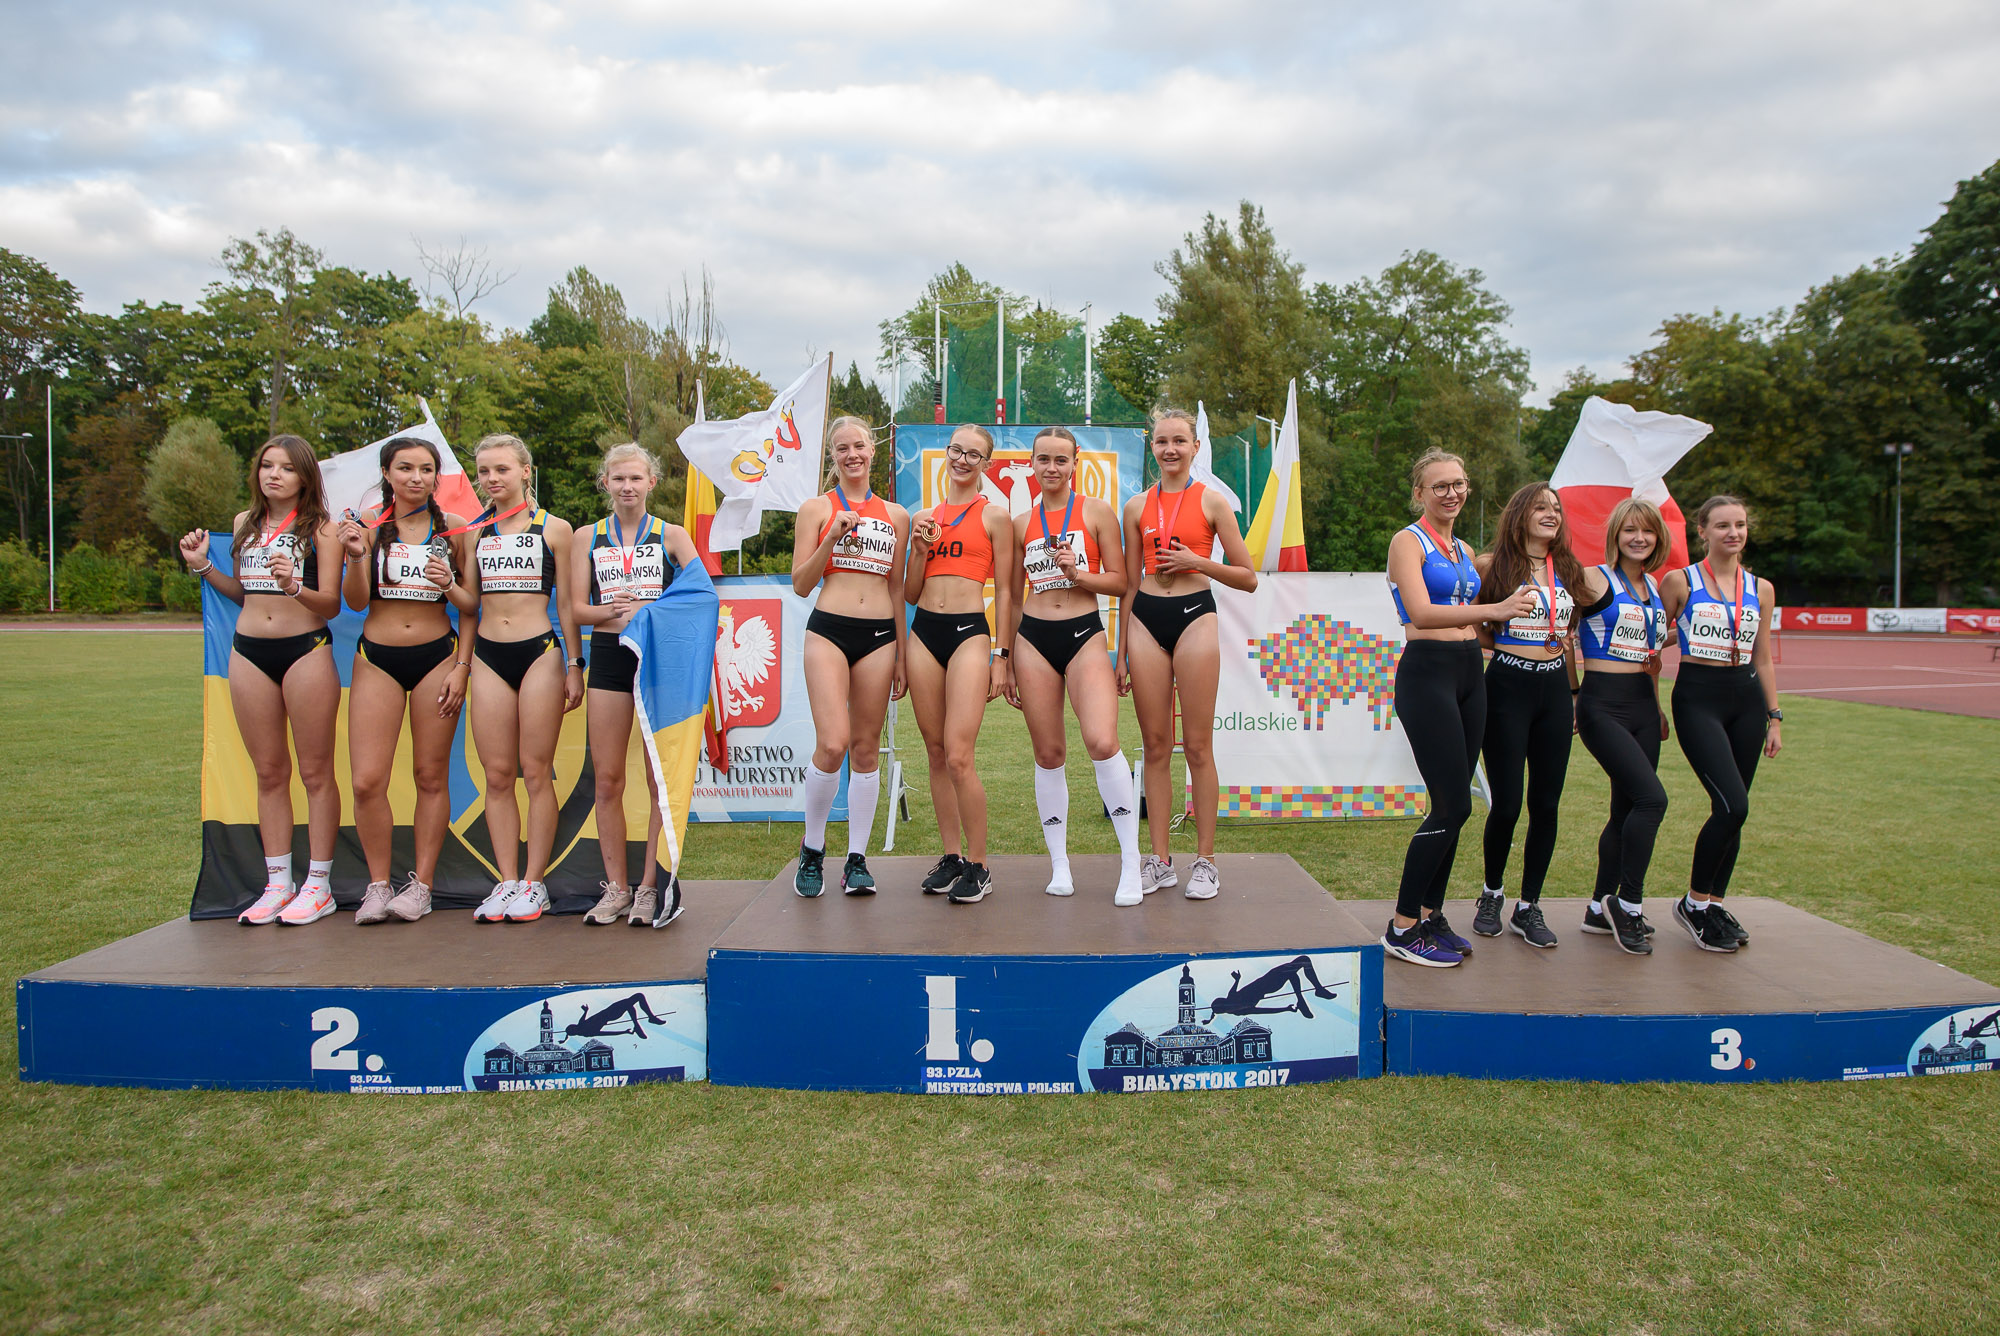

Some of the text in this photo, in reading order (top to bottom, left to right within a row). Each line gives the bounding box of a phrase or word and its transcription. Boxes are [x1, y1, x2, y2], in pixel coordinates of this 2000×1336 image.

[872, 520, 894, 536] 120
[515, 535, 534, 548] 38
[635, 545, 655, 558] 52
[482, 556, 536, 572] FĄFARA
[598, 555, 621, 563] ORLEN
[598, 565, 662, 583] WIŚNWSKA
[519, 581, 538, 589] 2022
[381, 589, 425, 599] BIAŁYSTOK
[1496, 652, 1562, 672] NIKE PRO
[1213, 712, 1297, 730] odlaskie
[726, 765, 808, 784] TURYSTYK
[751, 785, 793, 798] POLSKIEJ
[1974, 1061, 1994, 1072] 2017
[498, 1075, 629, 1092] BIAŁYSTOK 2017
[1122, 1068, 1290, 1092] BIAŁYSTOK 2017
[926, 1082, 1075, 1094] MISTRZOSTWA POLSKI
